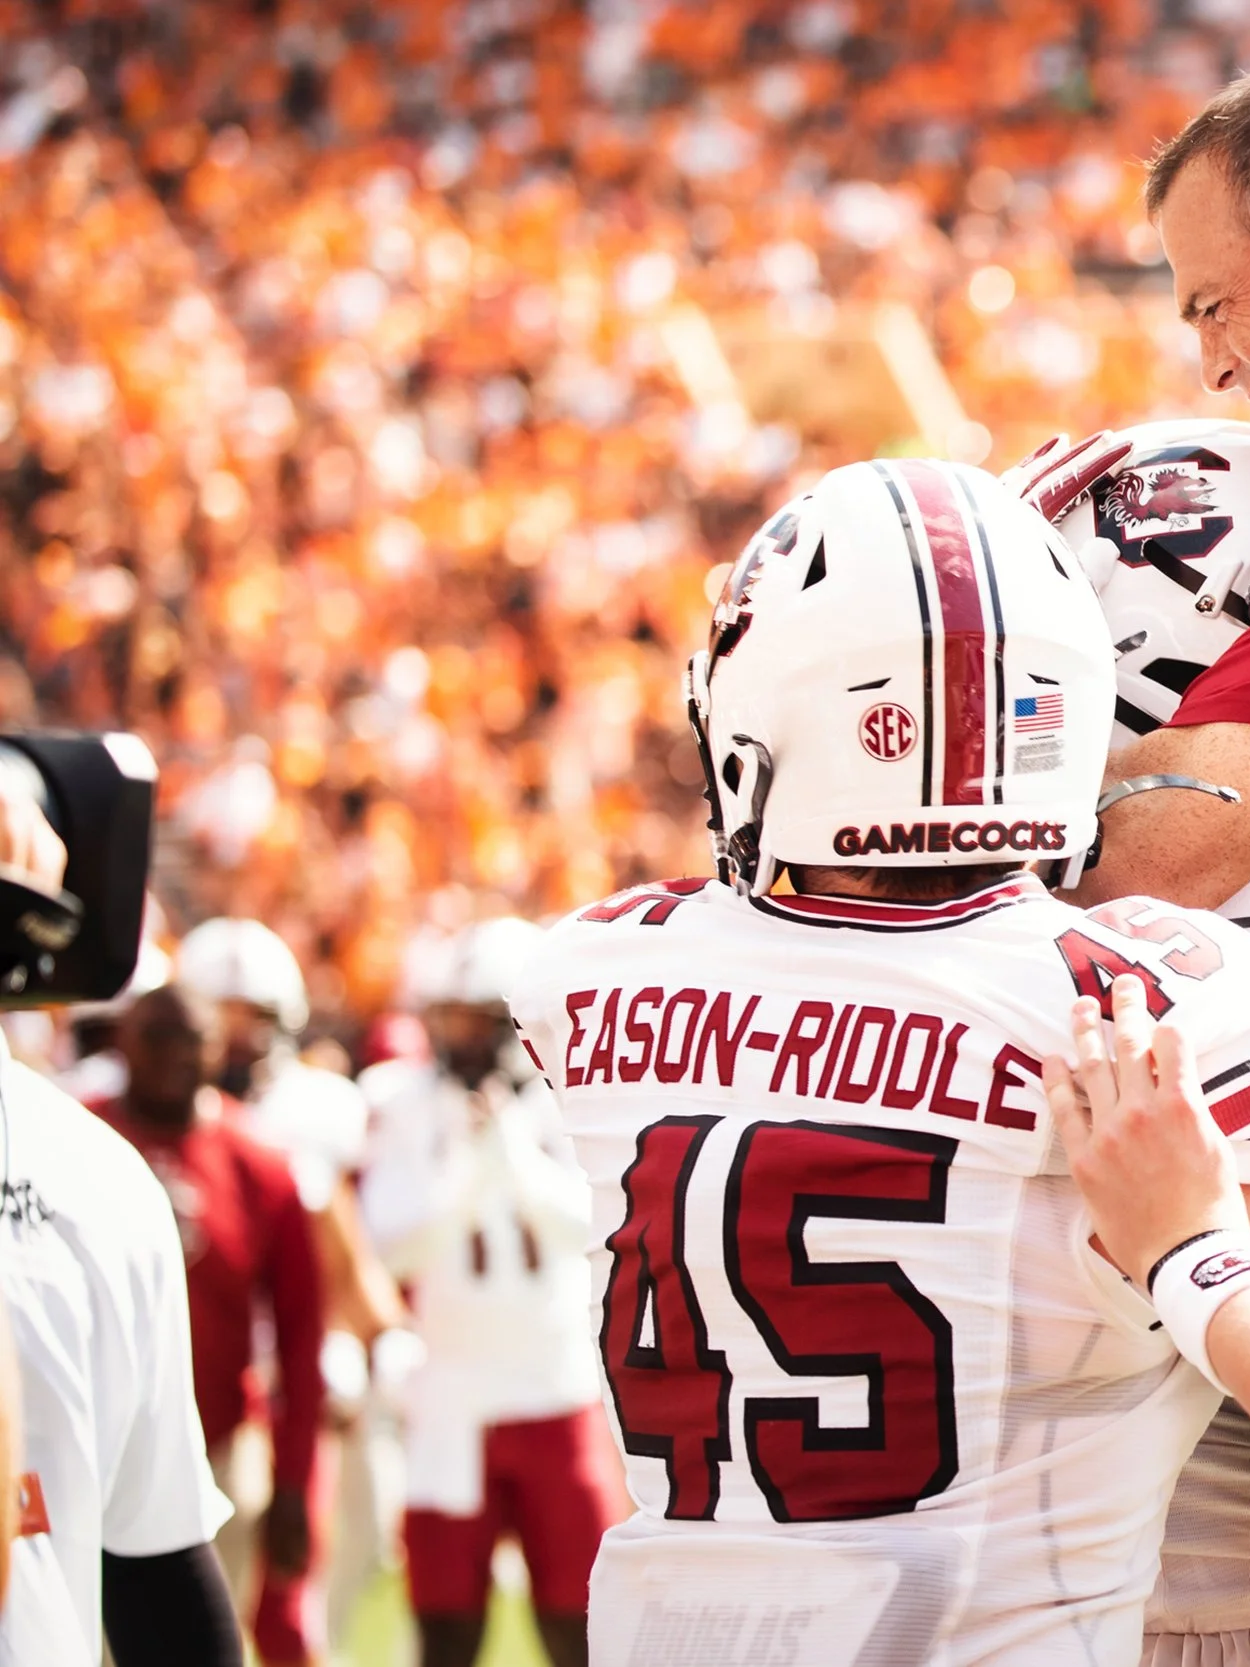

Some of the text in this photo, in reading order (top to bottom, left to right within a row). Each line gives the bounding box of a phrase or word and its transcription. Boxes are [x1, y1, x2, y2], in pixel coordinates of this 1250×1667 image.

[864, 707, 912, 758] SEC
[833, 820, 1067, 857] GAMECOCKS
[1054, 899, 1224, 1022] 45
[565, 986, 1043, 1133] EASON-RIDDLE
[600, 1115, 959, 1523] 45
